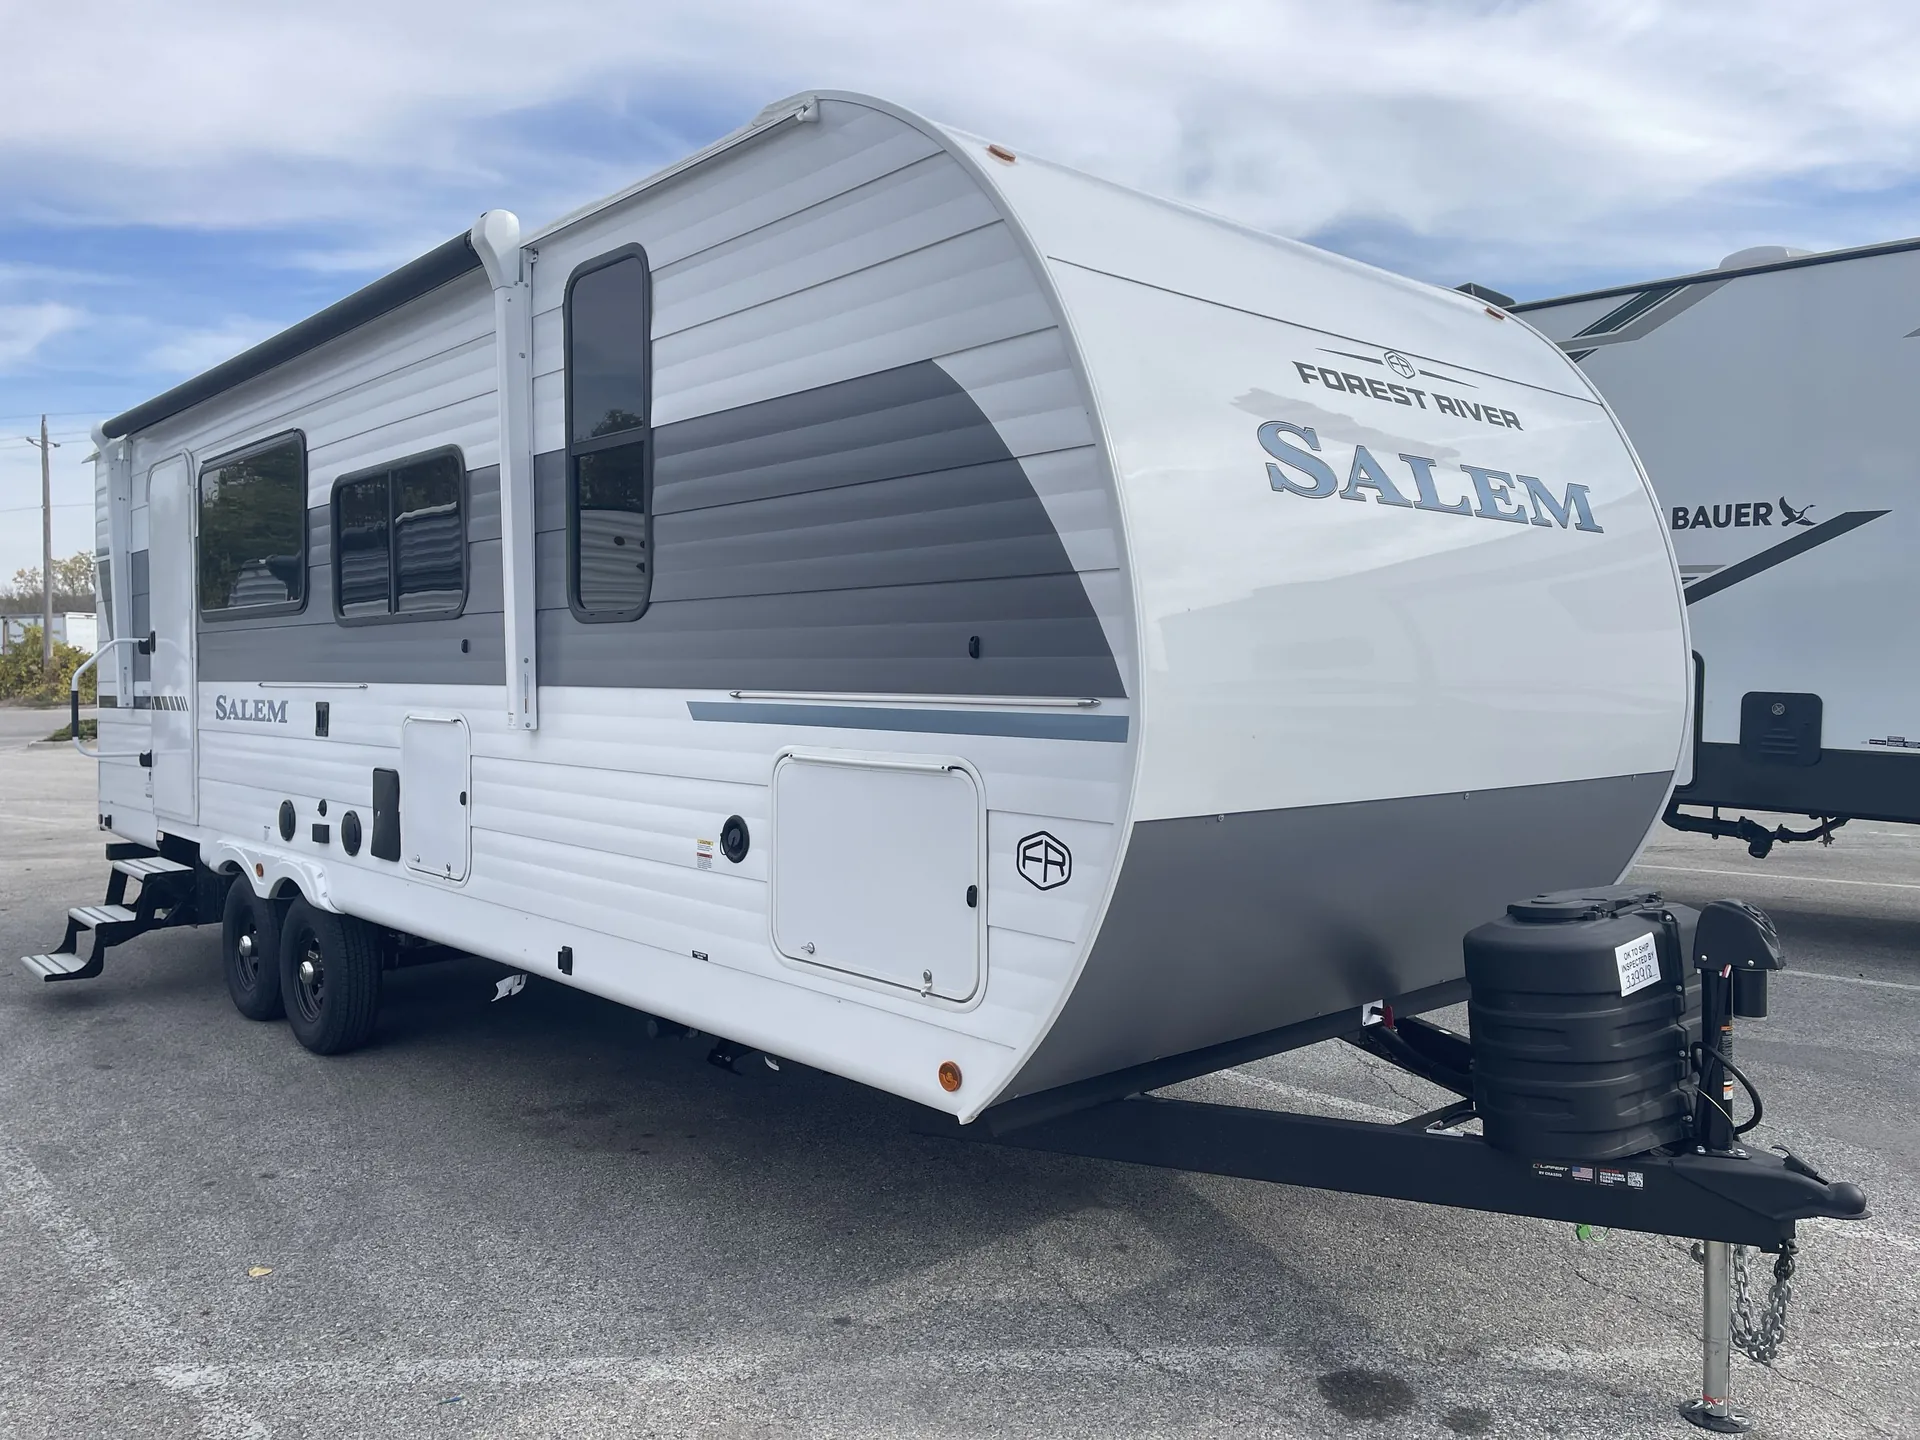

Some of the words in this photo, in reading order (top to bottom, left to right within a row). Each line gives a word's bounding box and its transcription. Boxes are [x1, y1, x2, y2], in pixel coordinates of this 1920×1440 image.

[1292, 360, 1428, 410] FOREST
[1431, 392, 1525, 432] RIVER
[1256, 419, 1605, 534] SALEM
[1671, 502, 1774, 530] BAUER
[215, 694, 289, 724] SALEM
[1622, 955, 1647, 972] INSPECTED
[1648, 951, 1654, 960] BY
[1624, 951, 1631, 960] OK
[1631, 947, 1638, 956] TO
[1639, 942, 1649, 954] SHIP
